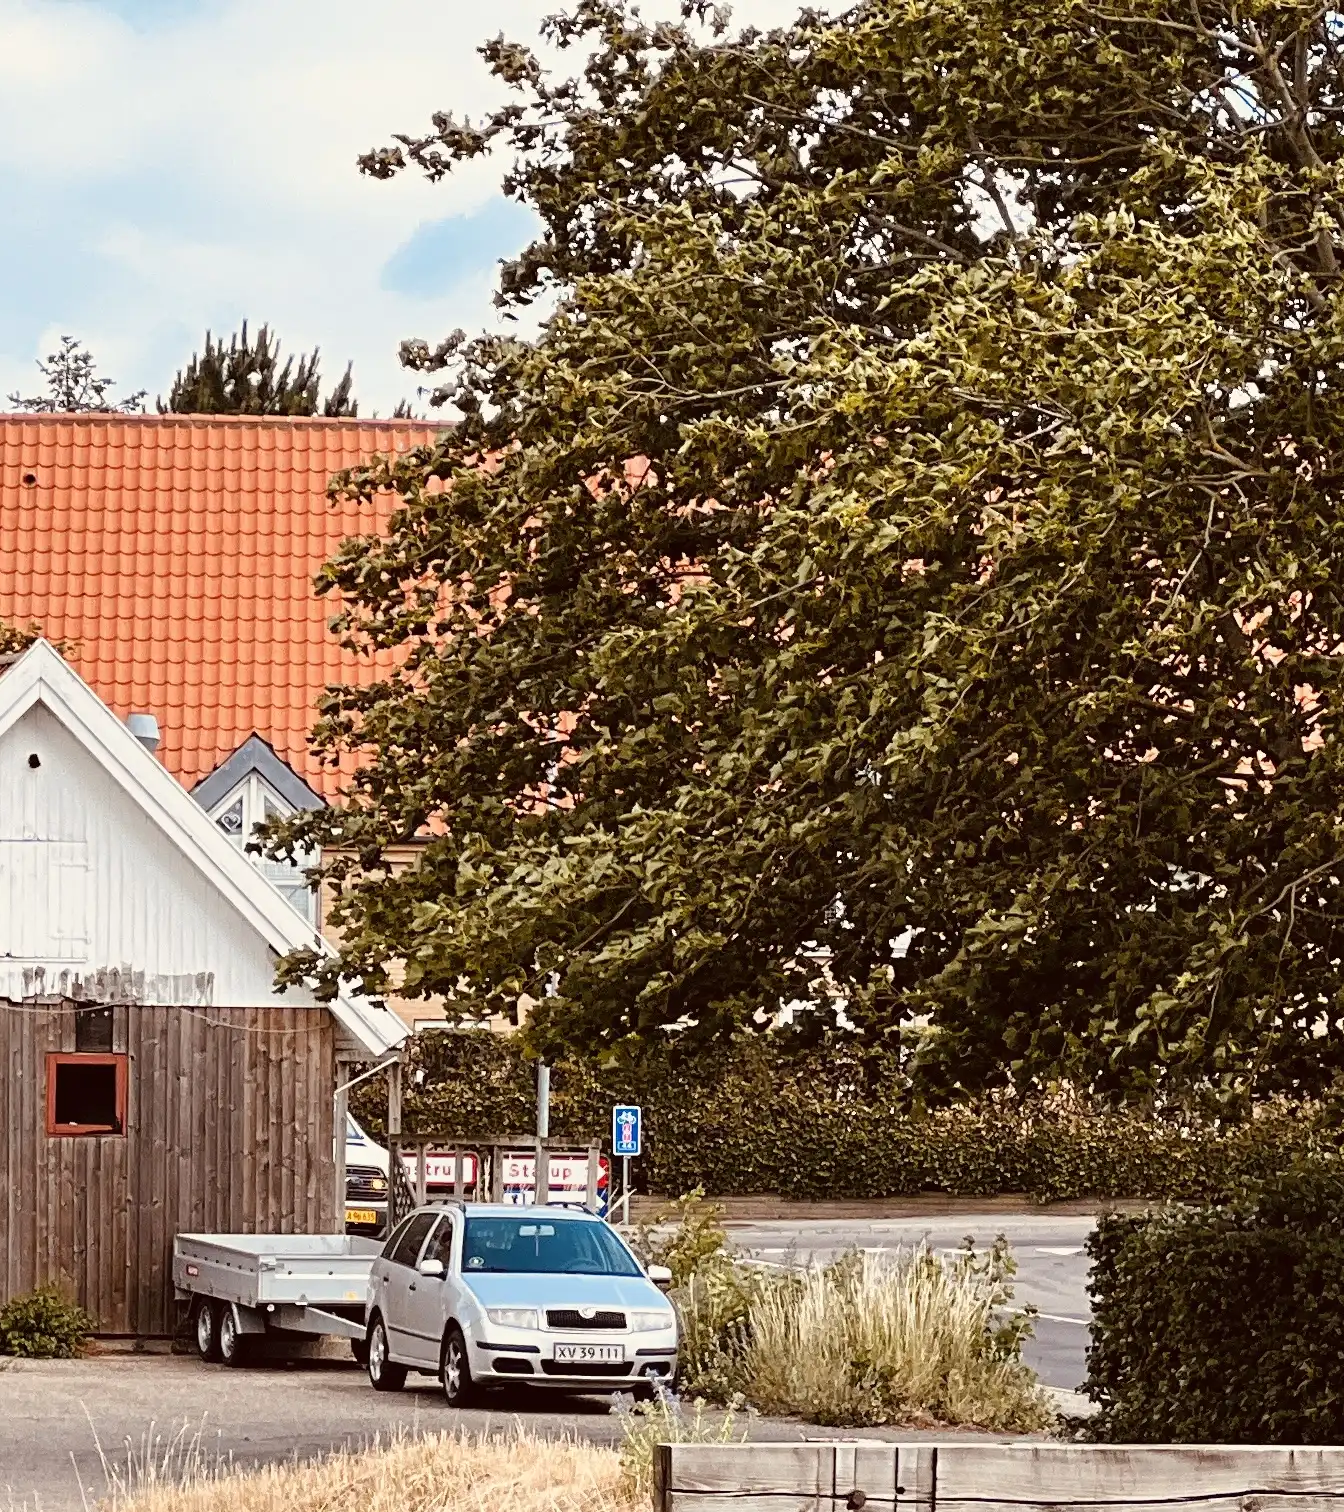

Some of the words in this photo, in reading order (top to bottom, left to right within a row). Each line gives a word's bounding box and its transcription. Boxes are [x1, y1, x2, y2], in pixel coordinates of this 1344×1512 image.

[558, 1347, 576, 1358] XV
[580, 1347, 595, 1358] 39
[599, 1347, 618, 1359] 111
